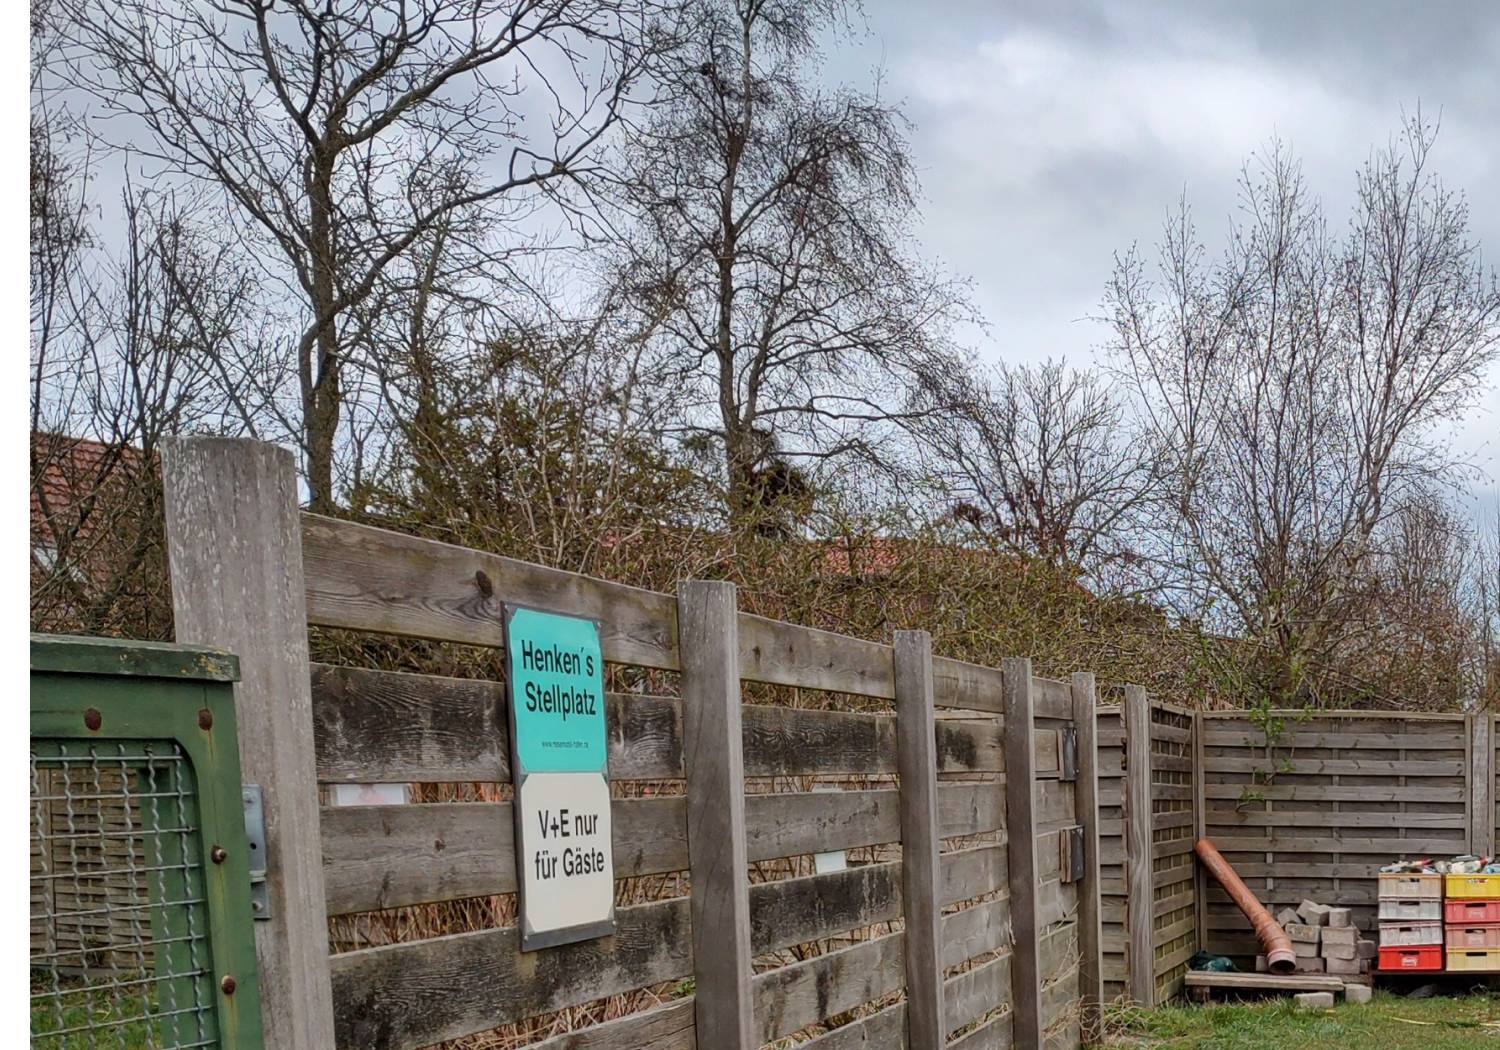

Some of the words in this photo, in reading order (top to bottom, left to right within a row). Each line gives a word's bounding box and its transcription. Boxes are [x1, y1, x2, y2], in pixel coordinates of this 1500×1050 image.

[525, 681, 596, 721] Stellplatz
[538, 809, 570, 839] V+E
[575, 814, 598, 836] nur
[534, 850, 558, 881] für
[563, 847, 604, 877] Gäste
